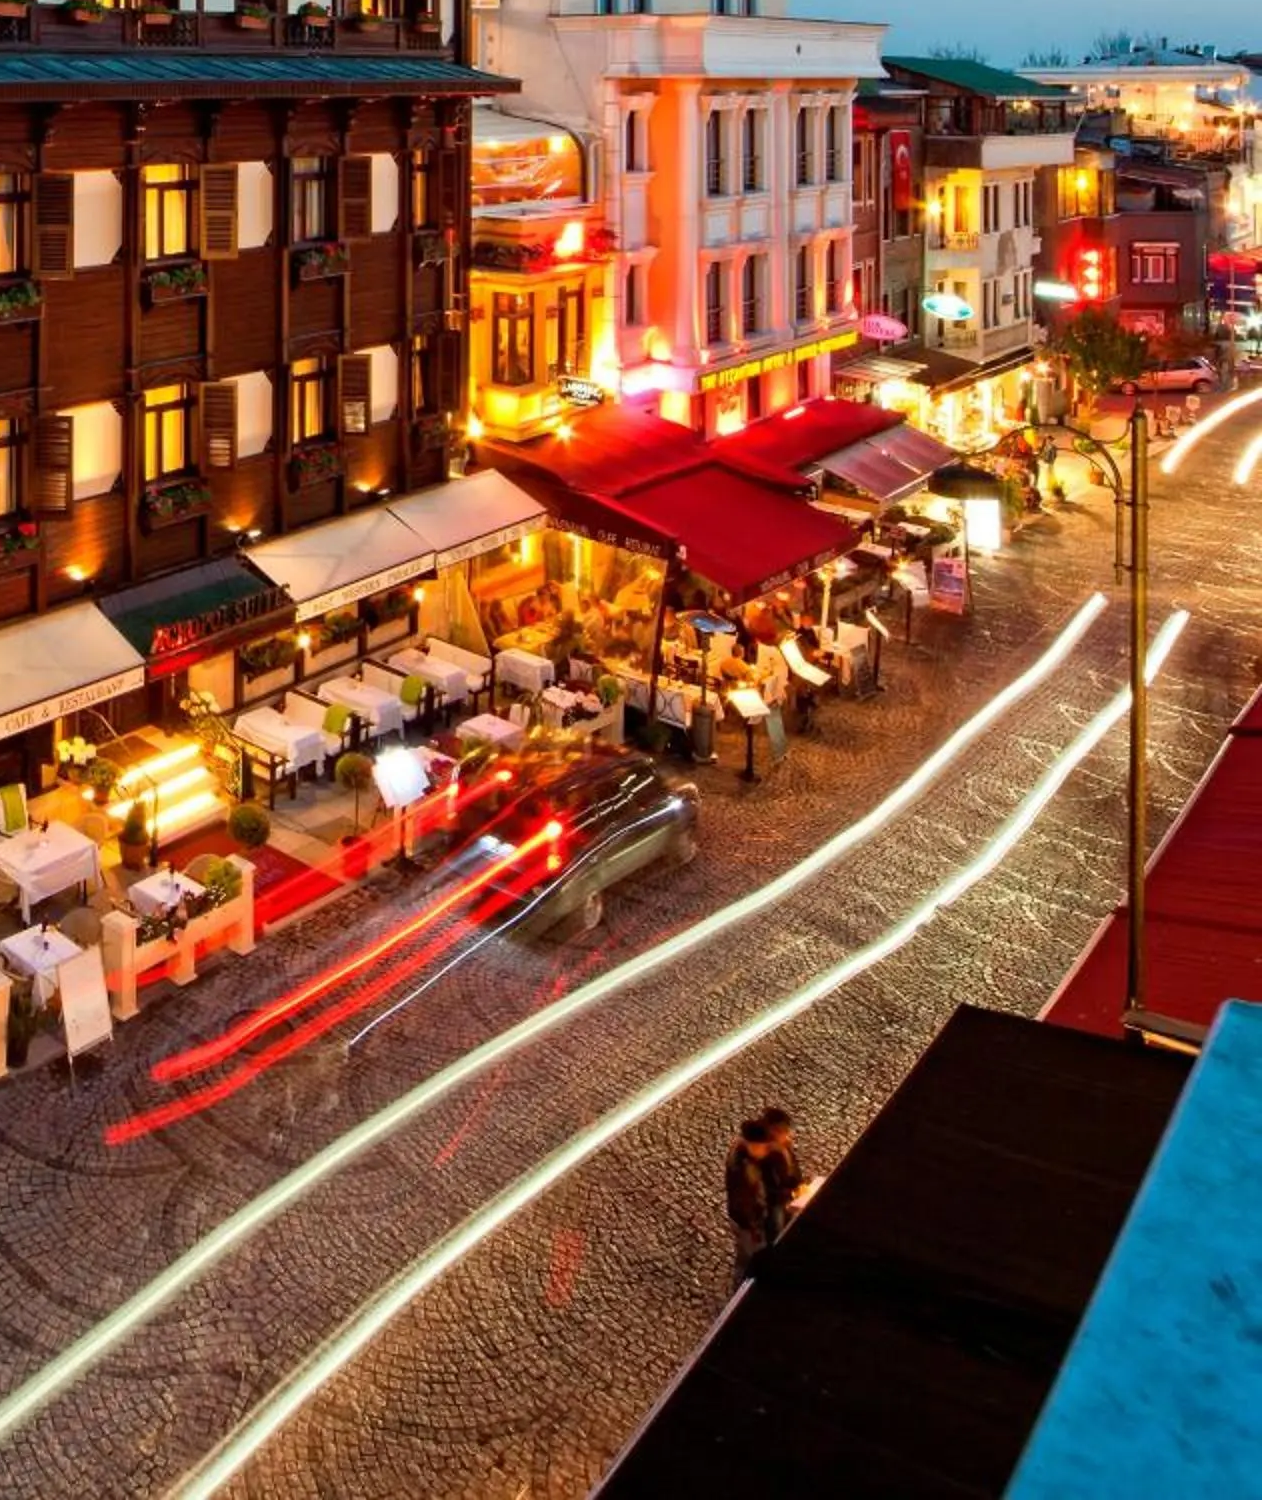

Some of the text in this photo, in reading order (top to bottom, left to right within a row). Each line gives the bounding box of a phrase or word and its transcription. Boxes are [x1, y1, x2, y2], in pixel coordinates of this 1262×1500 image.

[5, 710, 35, 732] CAFE
[41, 705, 50, 718] &
[58, 676, 125, 713] RESTAURANT
